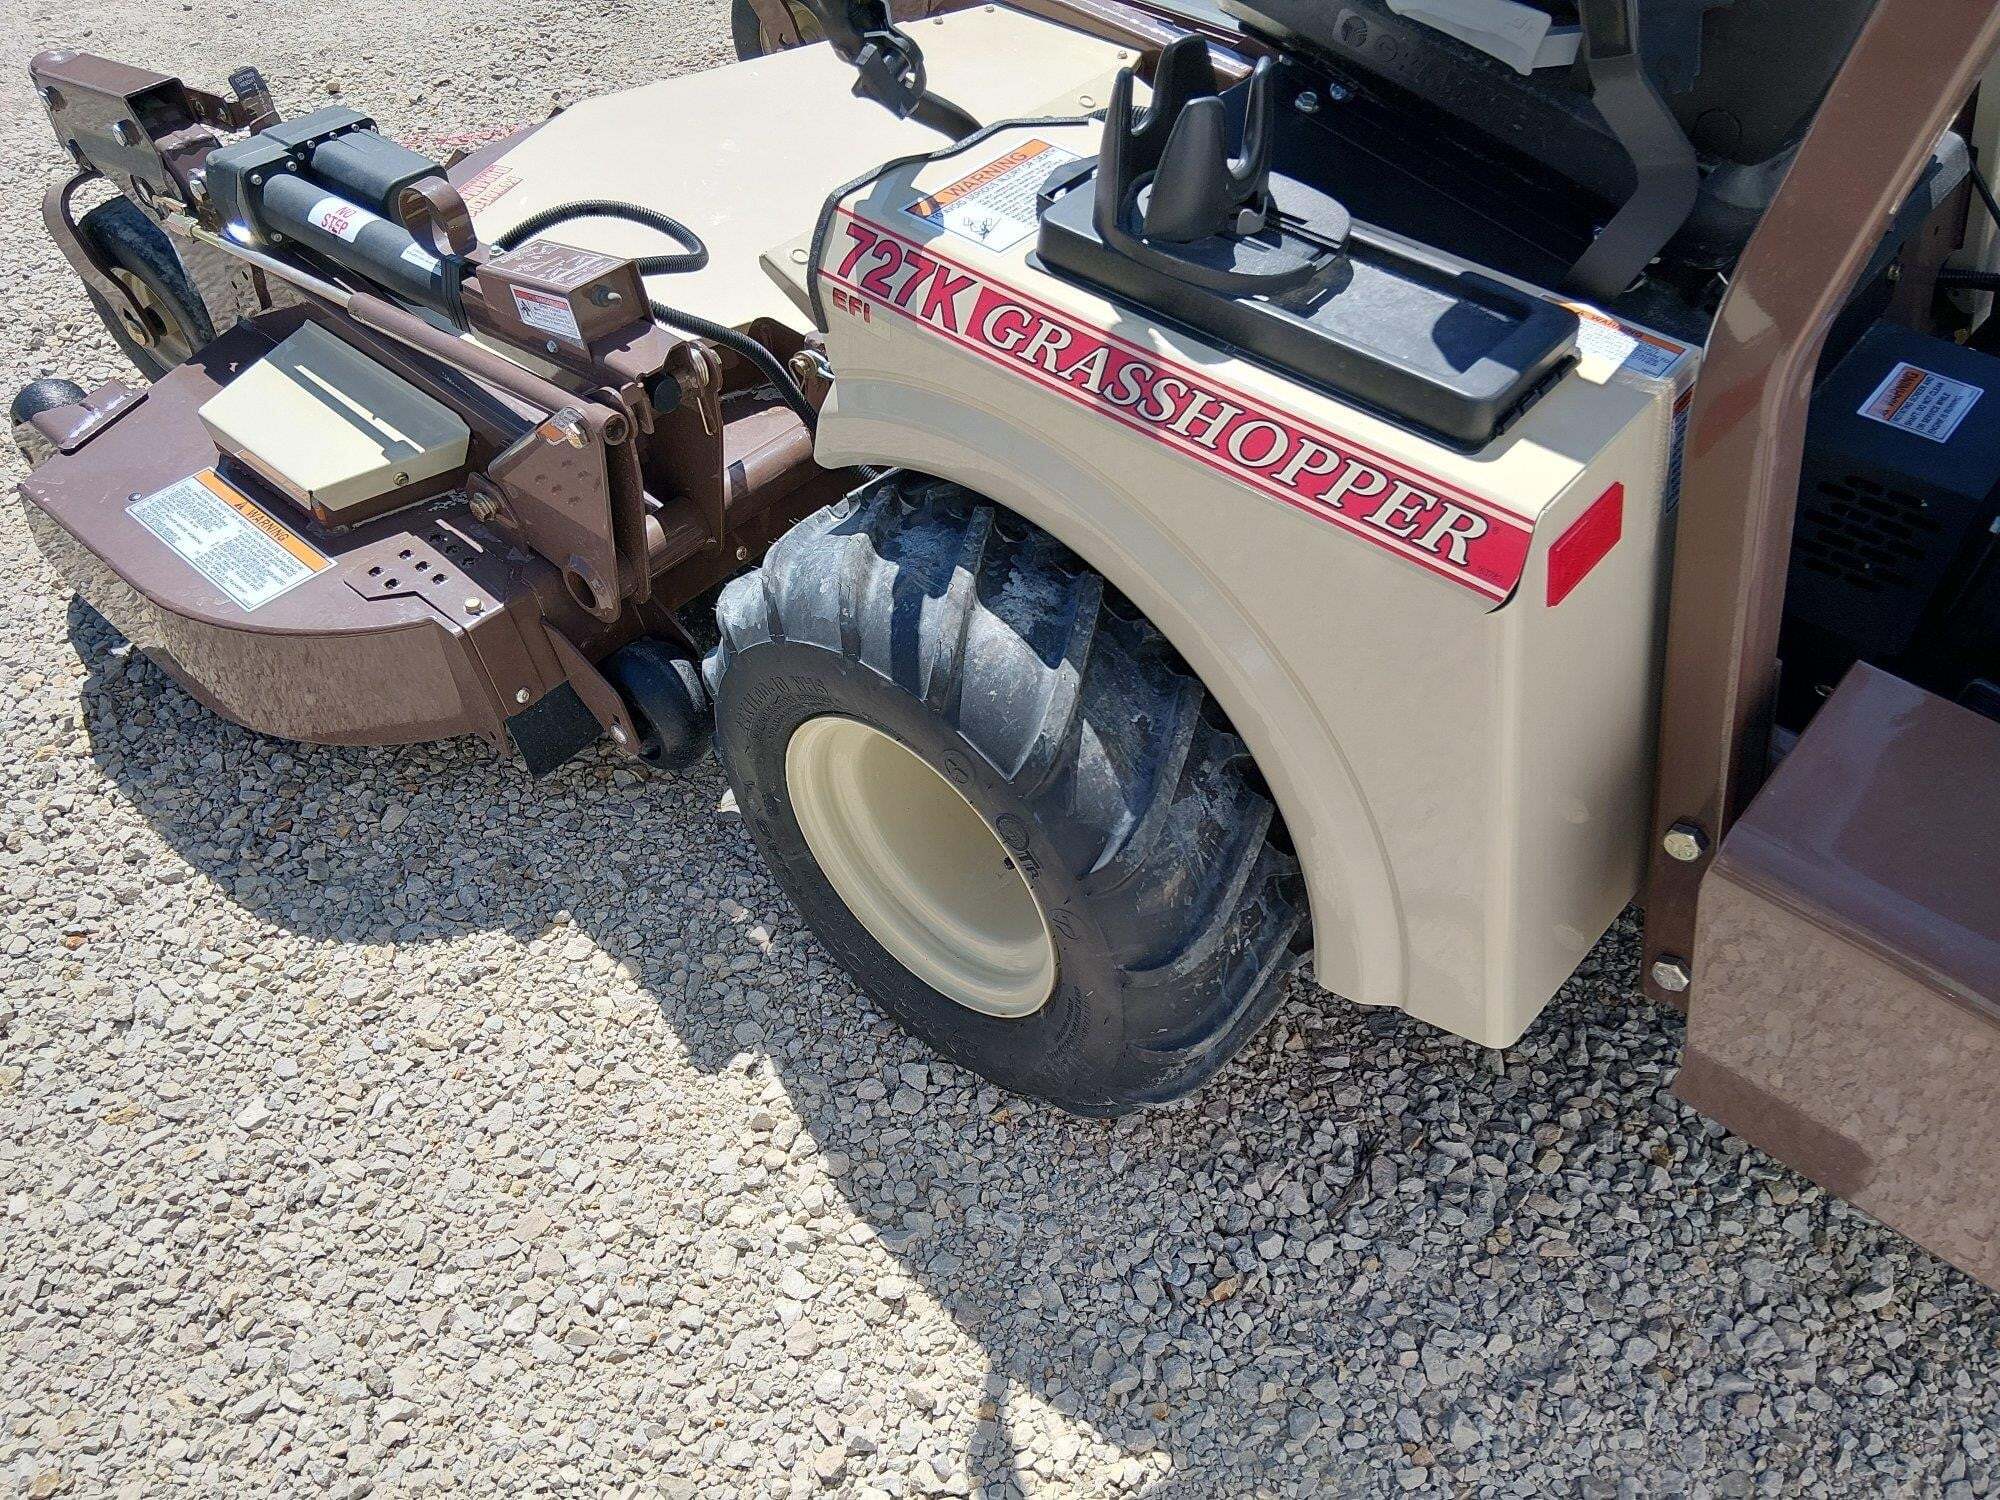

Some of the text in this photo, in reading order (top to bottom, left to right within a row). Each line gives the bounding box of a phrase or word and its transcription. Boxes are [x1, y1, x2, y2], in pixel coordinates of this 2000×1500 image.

[945, 151, 1030, 196] WARNING
[321, 213, 349, 234] STEP
[335, 206, 356, 219] NO
[832, 287, 871, 323] EFI
[836, 222, 978, 332] 727K
[981, 303, 1489, 566] GRASSHOPPER
[1886, 370, 1919, 406] WARNING
[247, 508, 291, 542] WARNING
